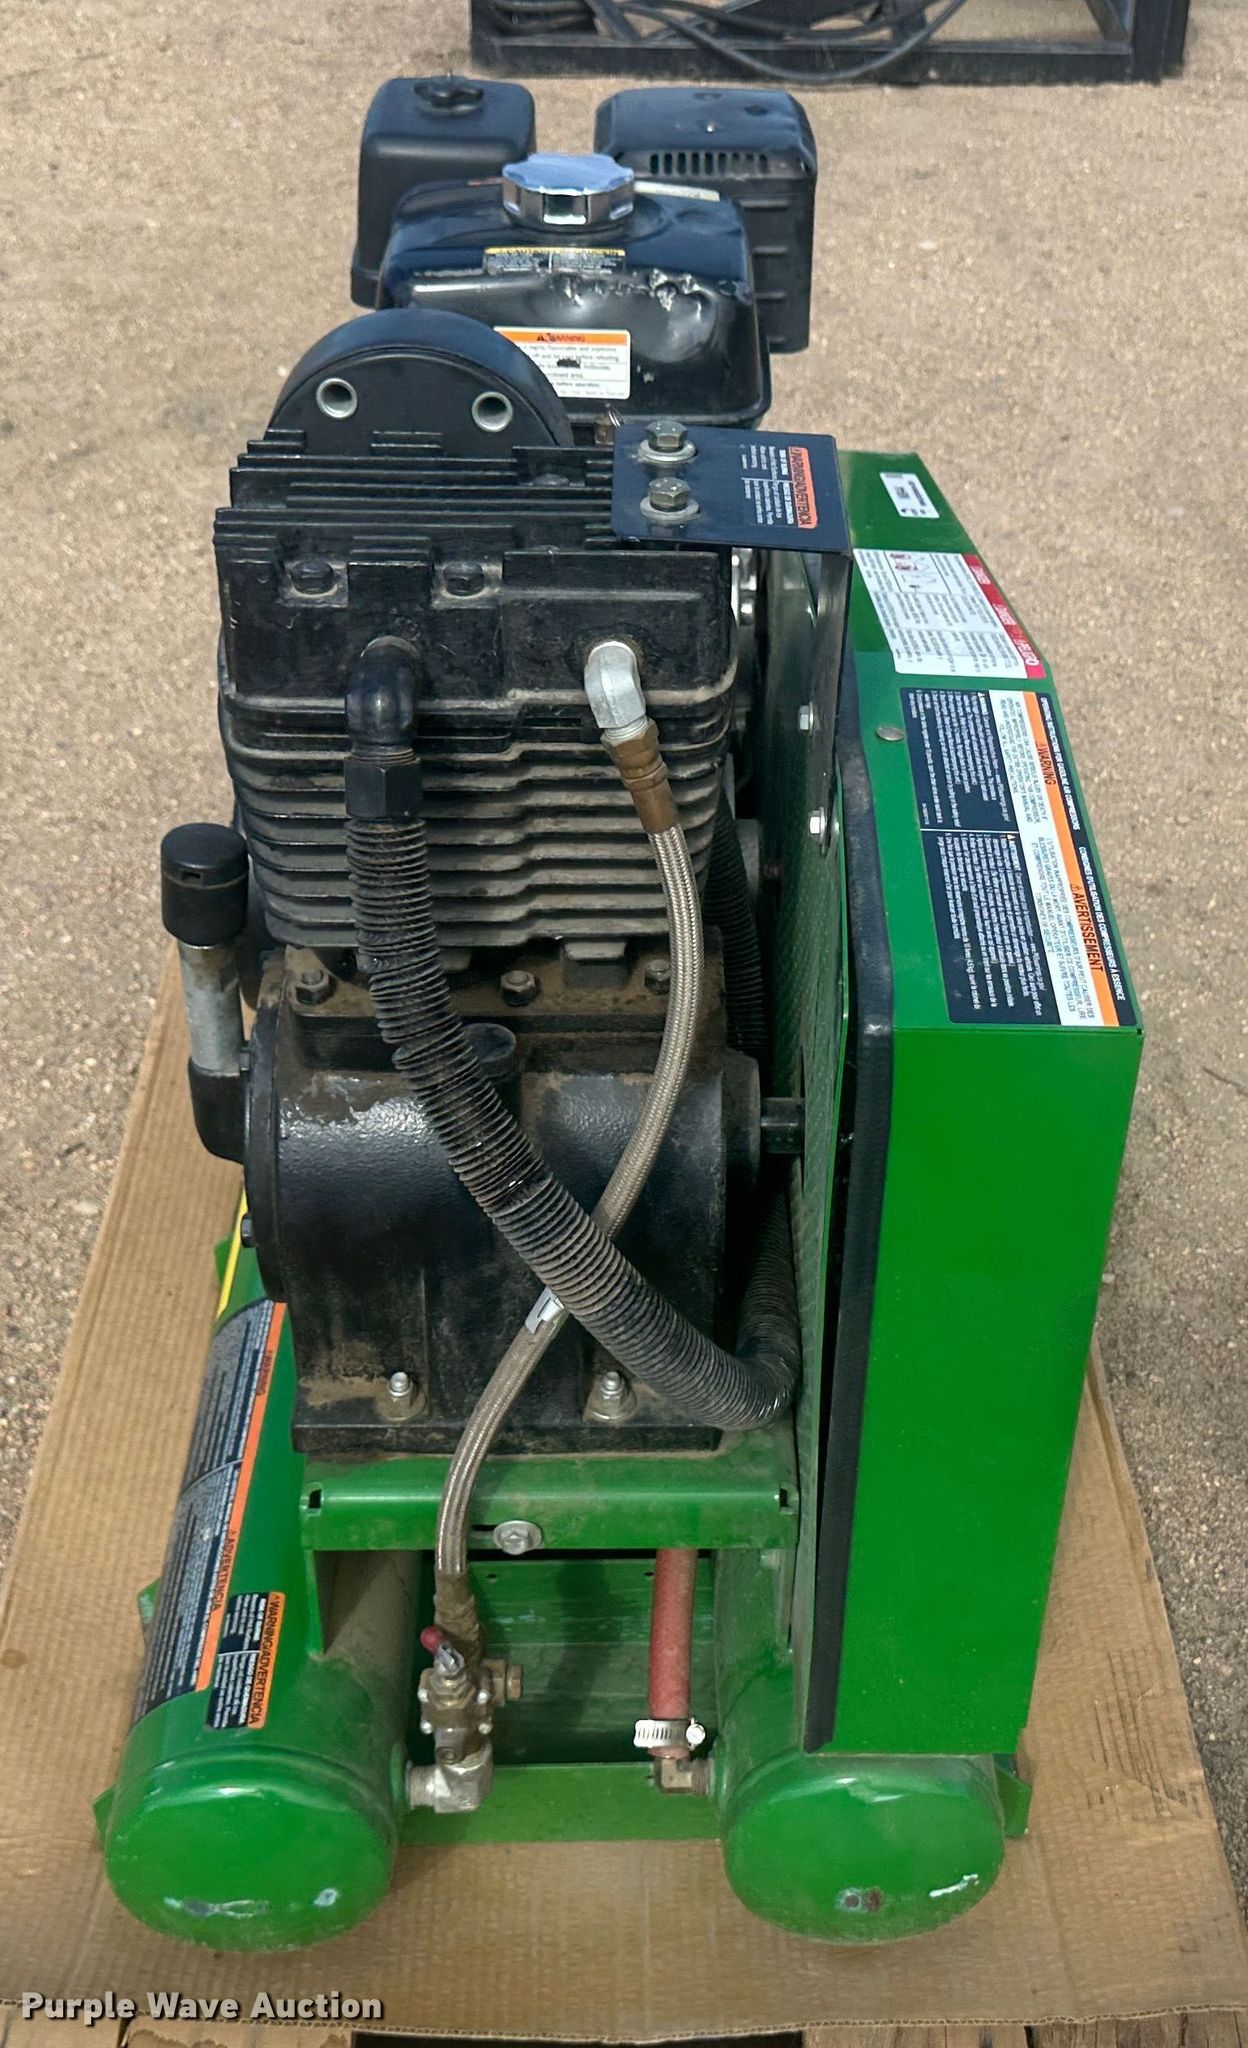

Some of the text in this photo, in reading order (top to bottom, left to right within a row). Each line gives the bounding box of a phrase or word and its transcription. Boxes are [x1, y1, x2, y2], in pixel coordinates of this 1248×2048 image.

[1037, 748, 1056, 784] WARNING
[1072, 893, 1103, 971] AVERTISSEMENT
[1094, 911, 1105, 922] DES
[1097, 923, 1116, 967] COMPRESSEURS
[1110, 973, 1125, 1000] ESSENCE
[210, 1533, 237, 1613] ADVERTENCIA
[249, 1601, 279, 1723] WARNING/ADVERTENCIA
